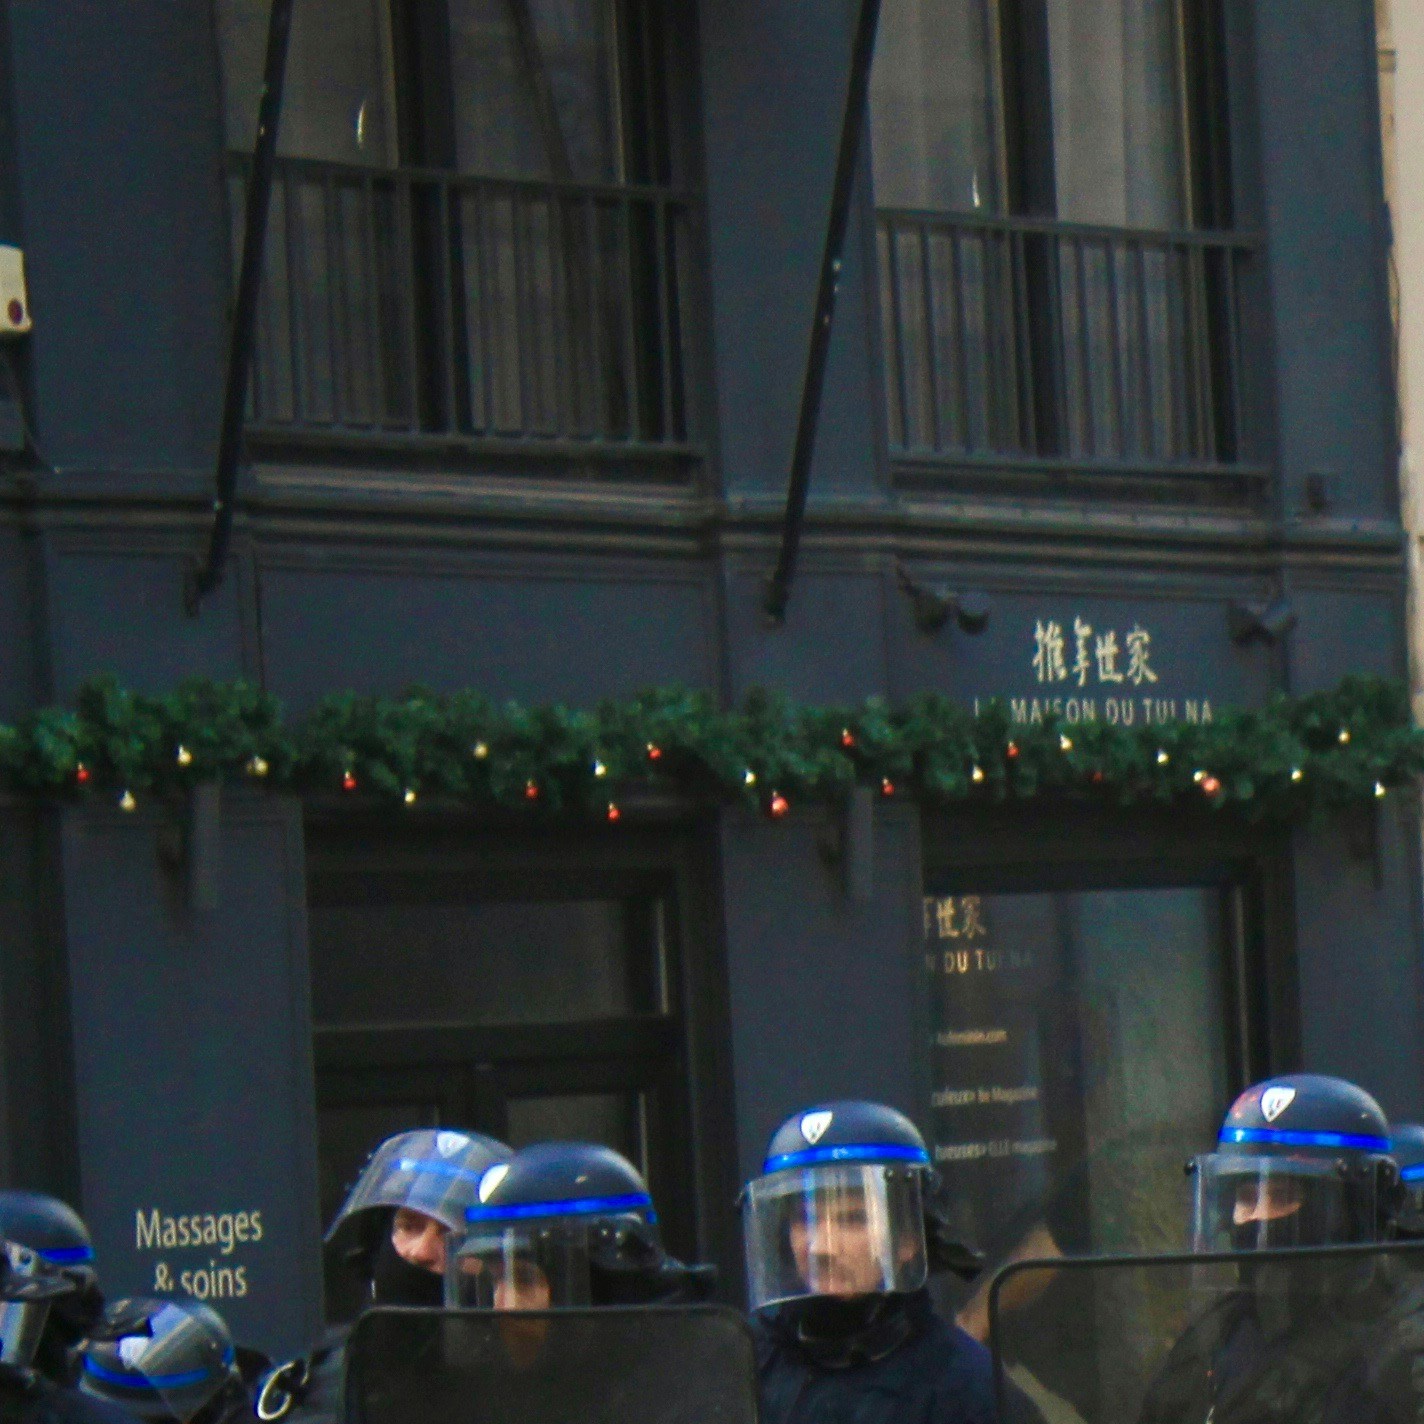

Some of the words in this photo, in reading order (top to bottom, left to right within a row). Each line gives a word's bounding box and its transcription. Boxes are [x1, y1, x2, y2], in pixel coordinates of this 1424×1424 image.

[1105, 697, 1135, 726] DU
[1142, 697, 1177, 725] TUI
[1185, 698, 1213, 725] NA
[135, 1208, 264, 1256] Massages
[154, 1261, 174, 1292] &
[180, 1259, 249, 1301] soins
